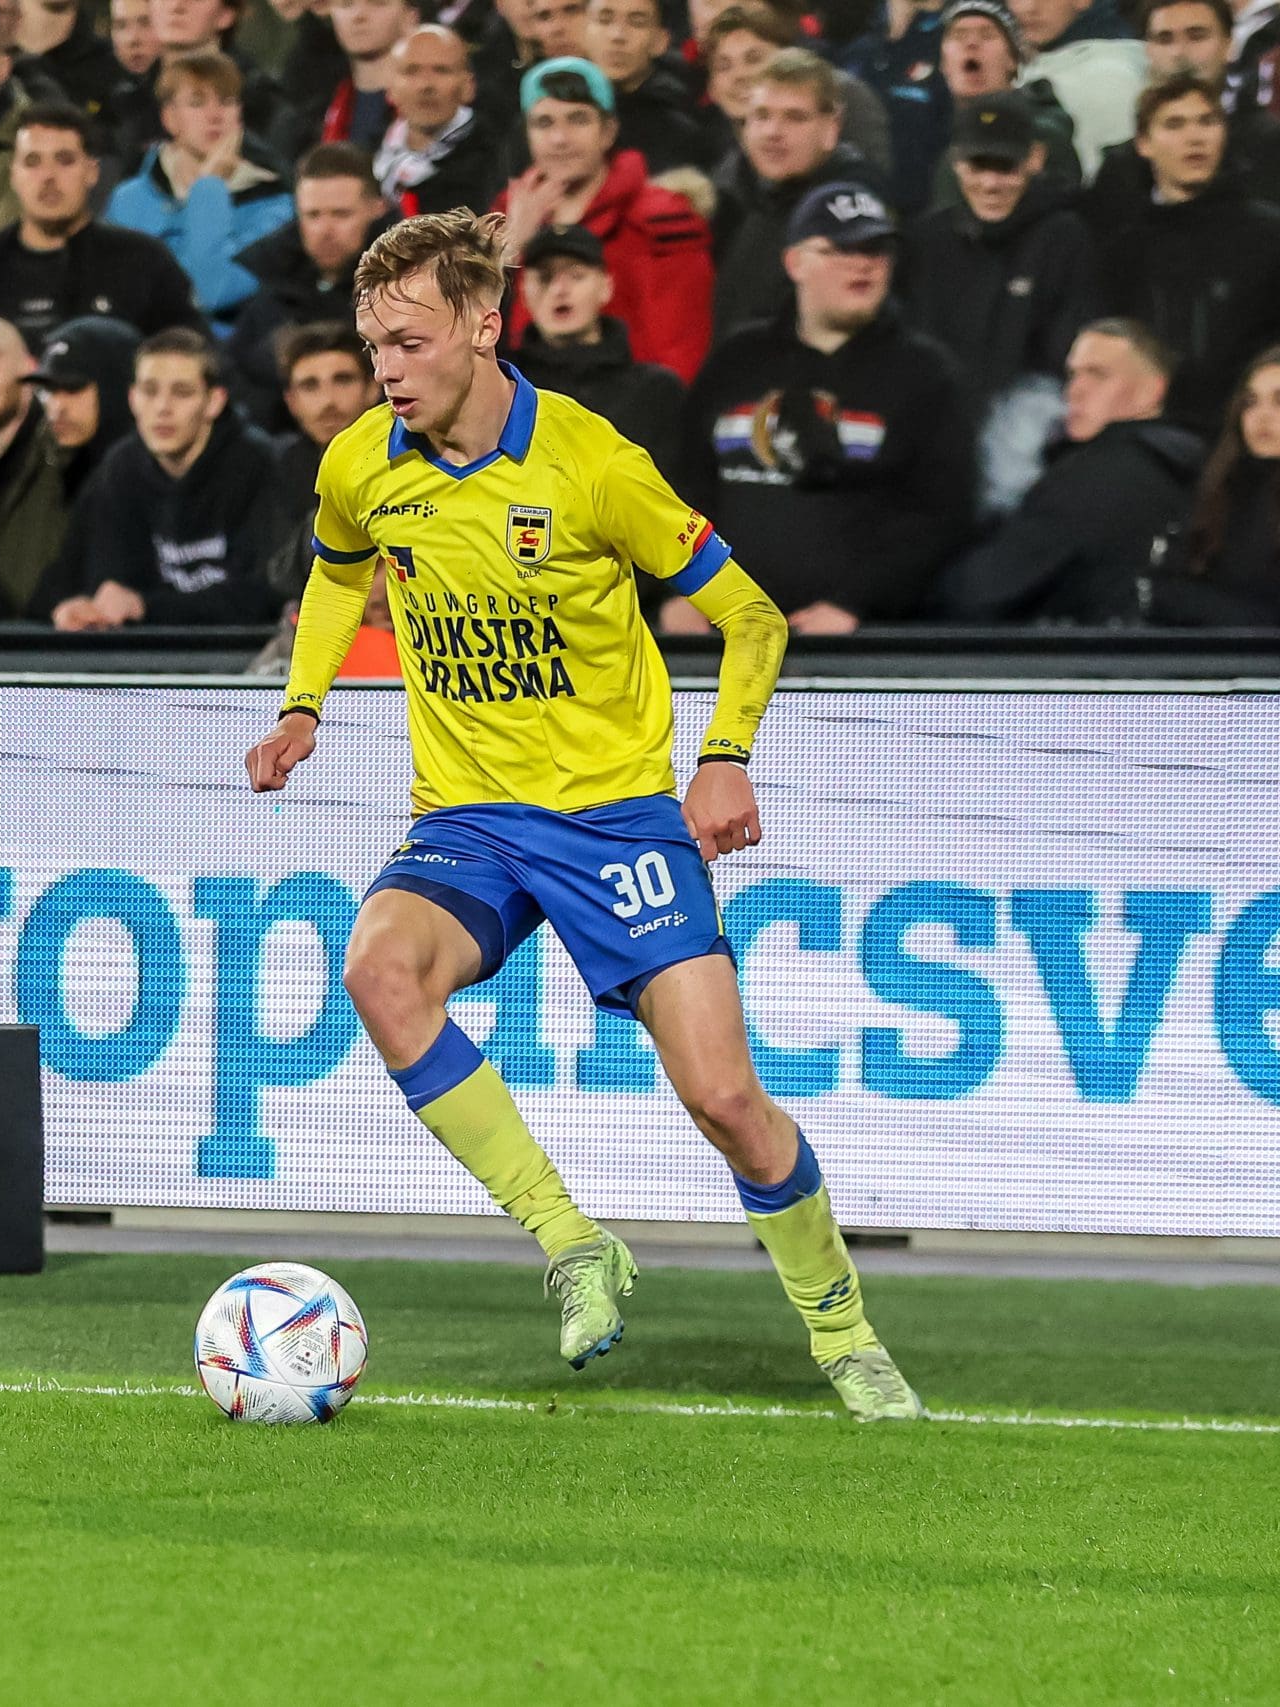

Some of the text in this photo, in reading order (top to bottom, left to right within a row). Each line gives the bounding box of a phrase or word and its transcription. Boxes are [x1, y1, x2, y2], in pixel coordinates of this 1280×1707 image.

[405, 608, 569, 661] DIJKSTRA
[599, 850, 676, 919] 30
[629, 914, 673, 939] CRAFT
